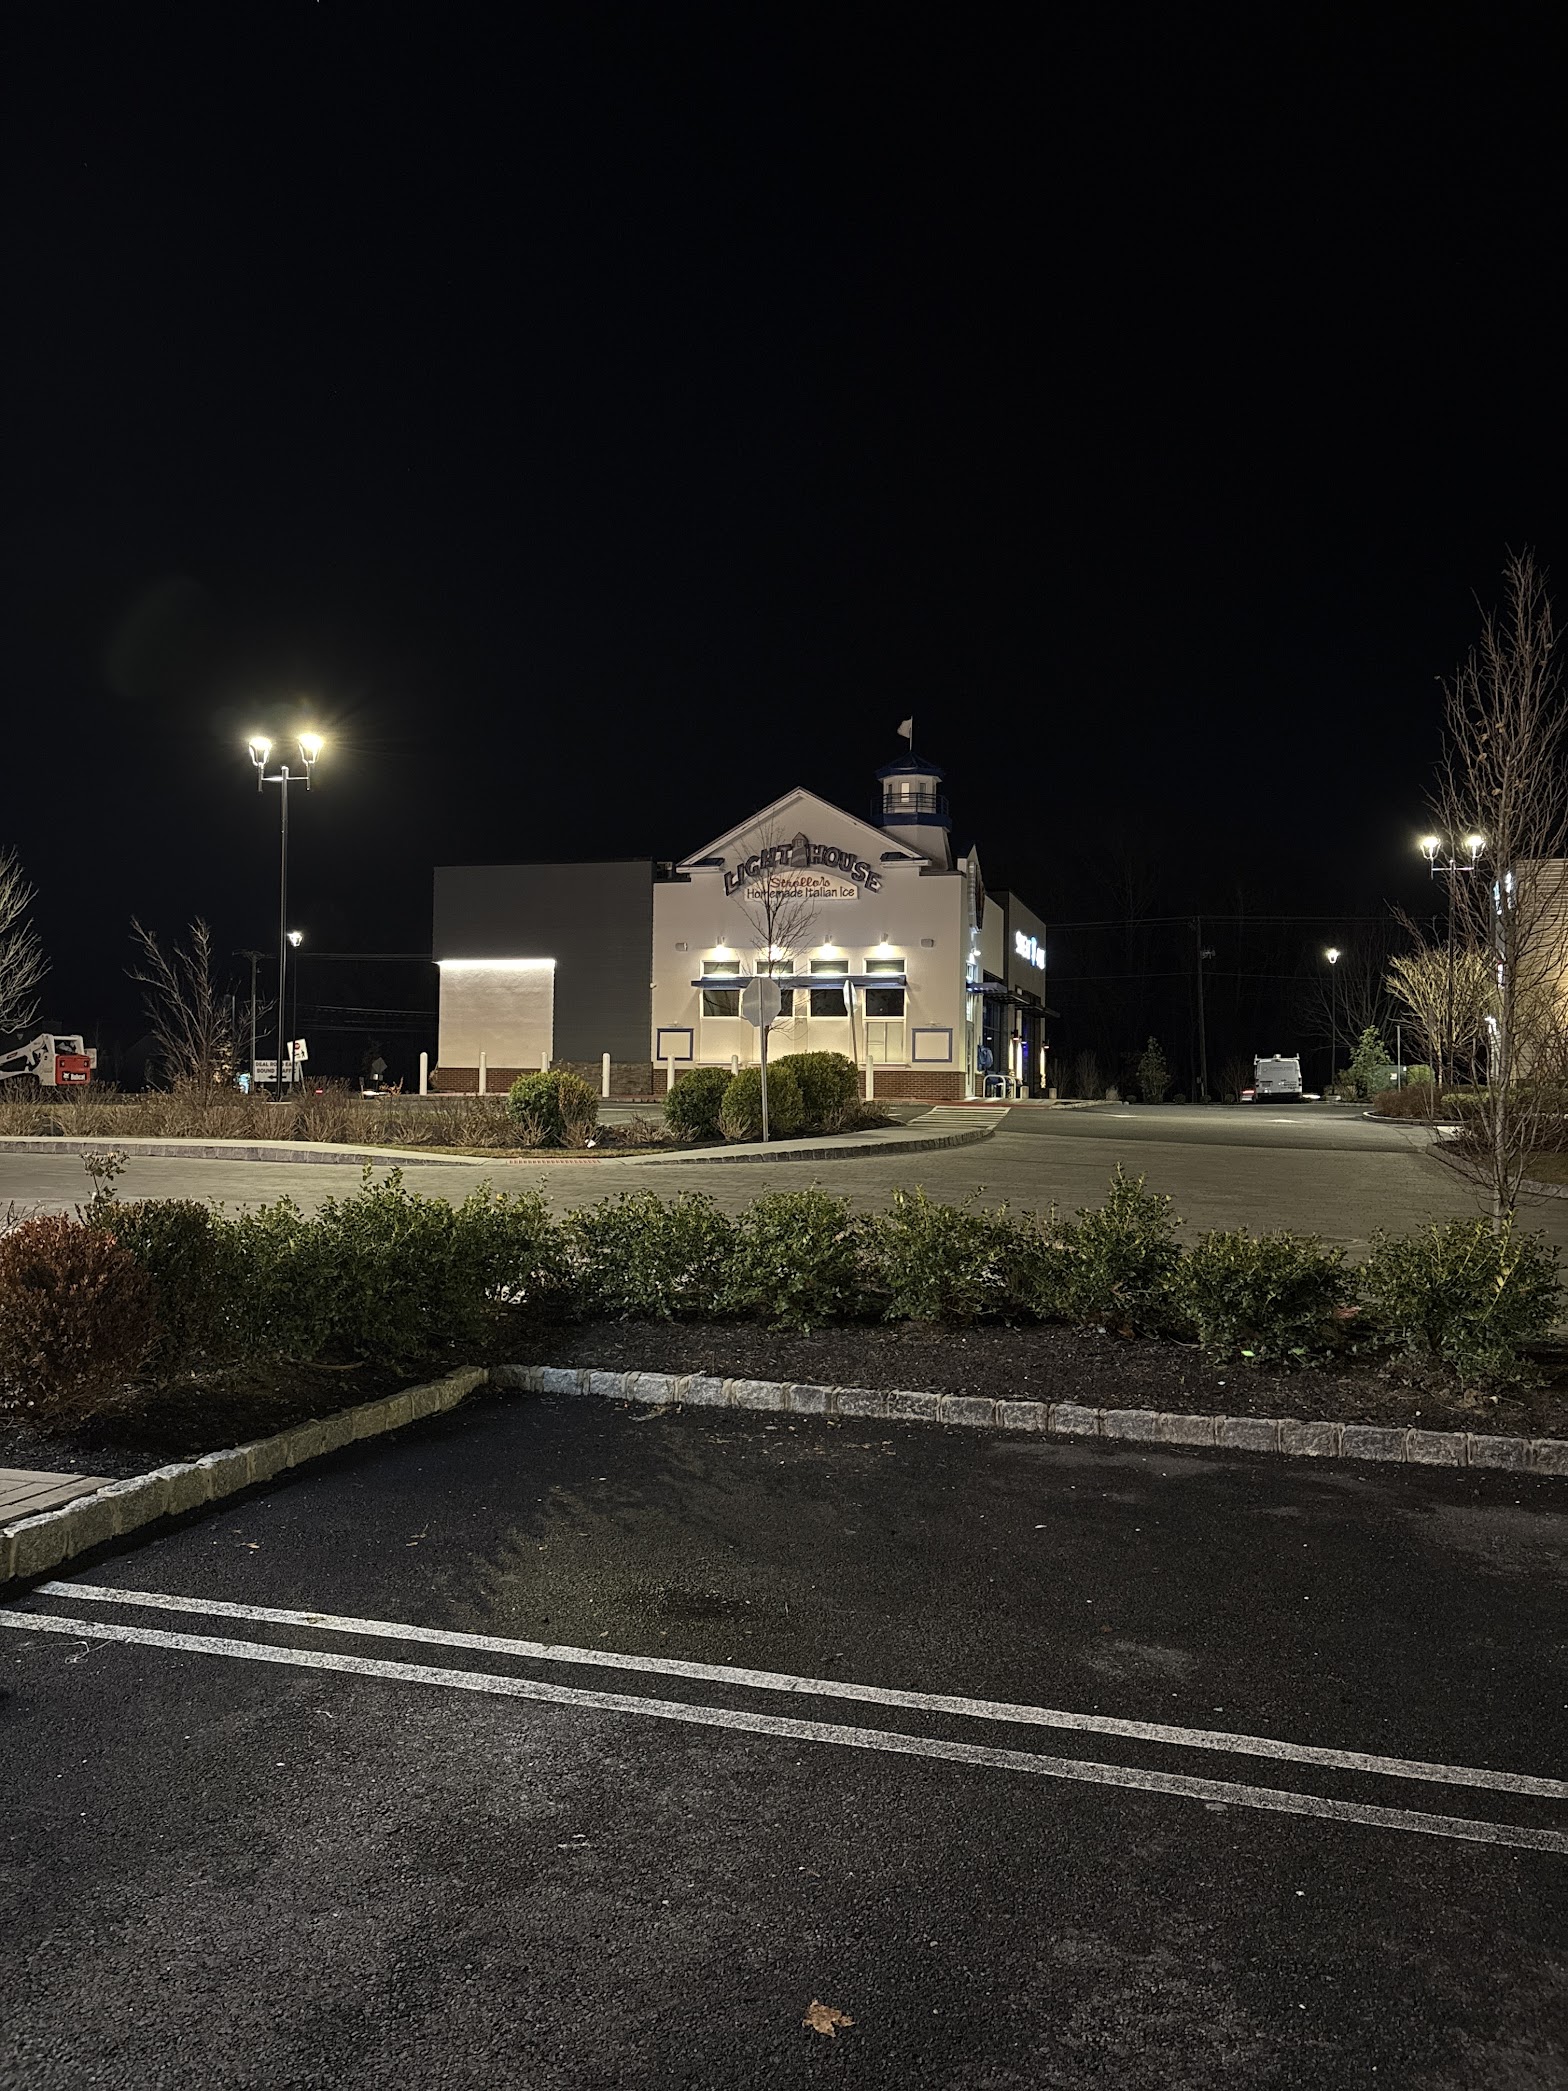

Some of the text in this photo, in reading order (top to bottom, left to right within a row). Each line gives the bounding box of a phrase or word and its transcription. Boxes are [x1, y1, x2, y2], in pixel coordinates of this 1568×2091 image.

[723, 844, 883, 896] LIGHT HOUSE
[747, 886, 855, 899] Homemade Italian Ice
